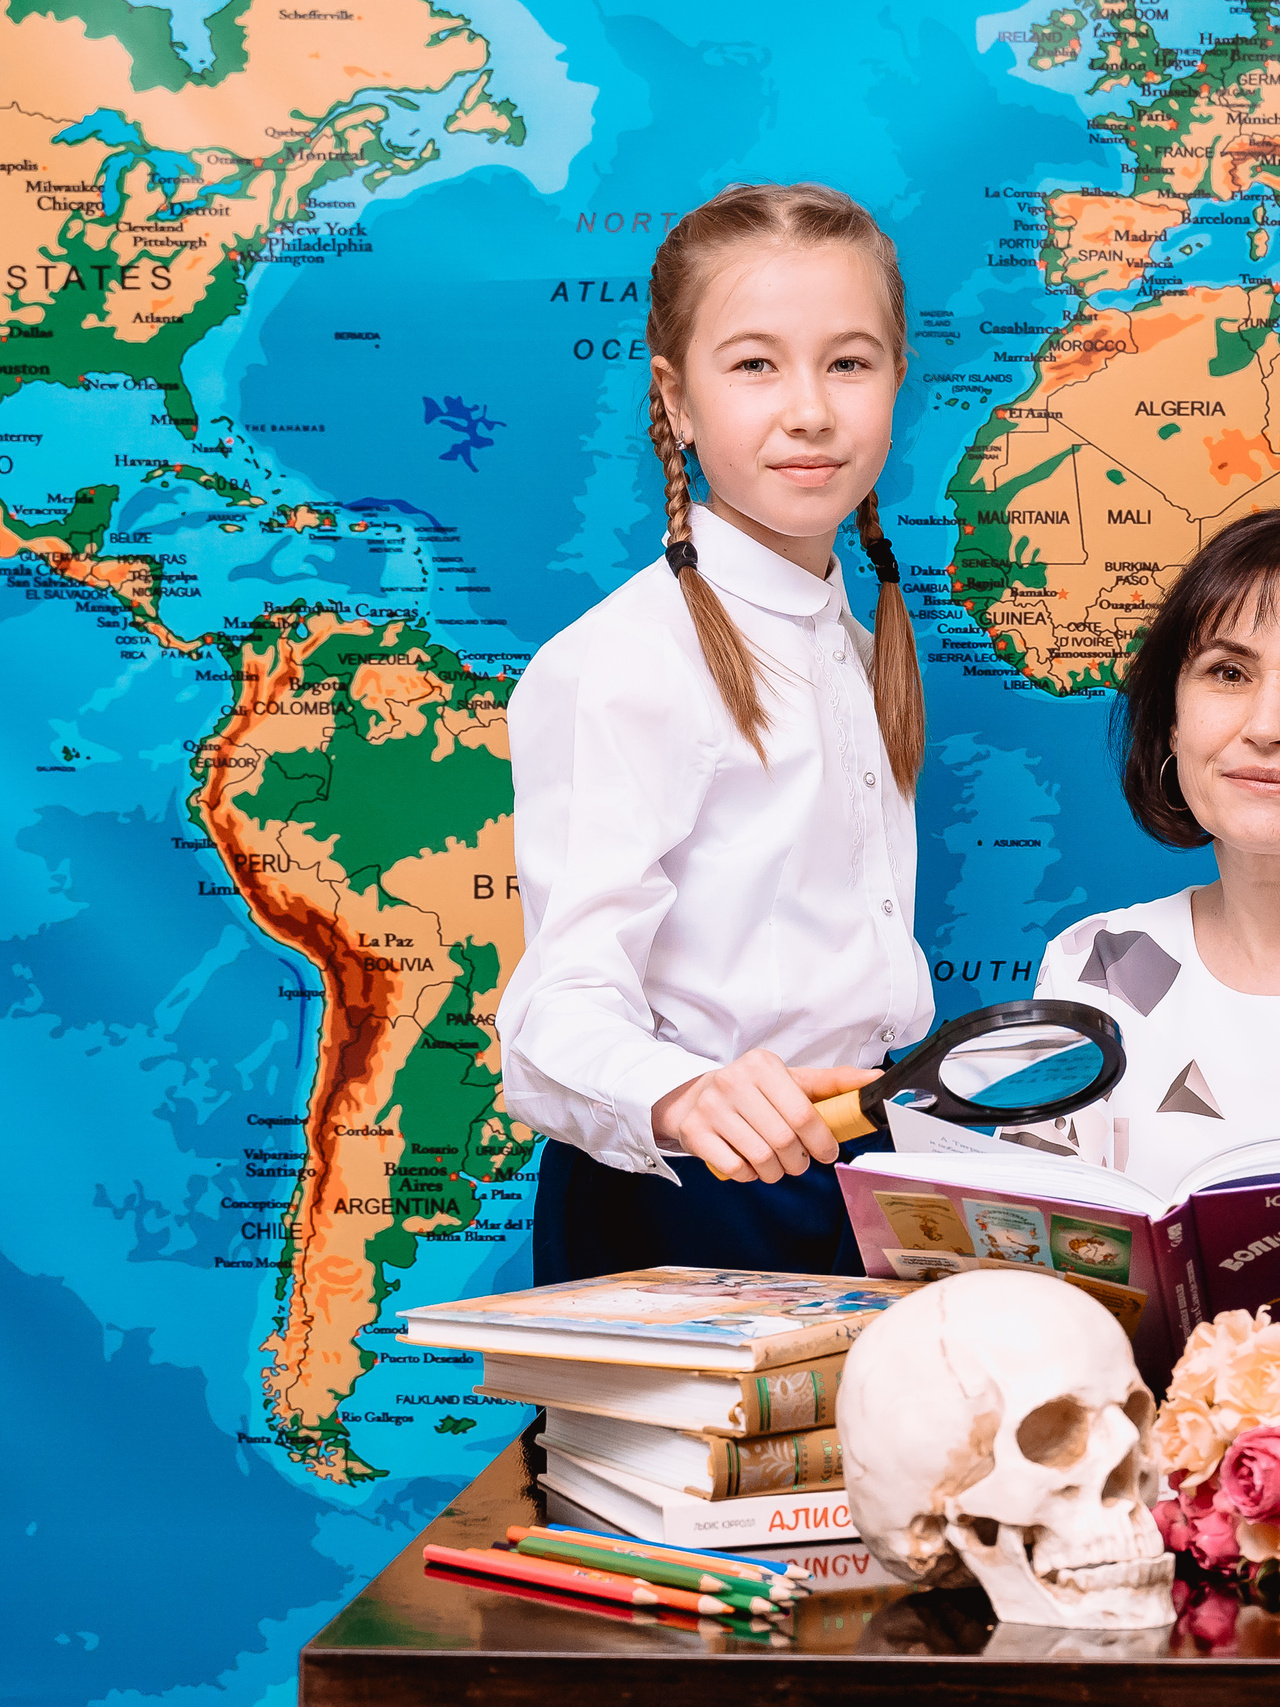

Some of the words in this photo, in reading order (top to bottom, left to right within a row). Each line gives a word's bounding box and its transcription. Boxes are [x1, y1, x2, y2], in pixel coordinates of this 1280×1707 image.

[1089, 58, 1146, 71] London
[1137, 110, 1171, 122] Paris
[286, 147, 364, 162] Montreal
[1155, 146, 1214, 158] FRANCE
[1121, 164, 1174, 174] Bordeaux
[26, 180, 105, 194] Milwaukee
[985, 188, 1000, 198] La
[1003, 188, 1047, 198] Coruna
[37, 196, 106, 213] Chicago
[169, 203, 231, 218] Detroit
[307, 199, 355, 210] Boston
[1016, 202, 1044, 214] Vigo
[576, 212, 677, 233] NORT
[1181, 212, 1250, 225] Barcelona
[116, 221, 184, 233] Cleveland
[280, 223, 320, 237] New
[327, 223, 367, 237] York
[1013, 222, 1047, 231] Porto
[1114, 230, 1167, 242] Madrid
[133, 236, 207, 249] Pittsburgh
[268, 238, 373, 256] Philadelphia
[987, 254, 1038, 266] Lisbon
[1078, 250, 1123, 262] SPAIN
[7, 266, 172, 290] STATES
[550, 281, 652, 302] ATLA
[132, 312, 184, 324] Atlanta
[1062, 310, 1098, 321] Rabat
[8, 327, 54, 338] Dallas
[979, 322, 1060, 334] Casablanca
[573, 339, 646, 360] OCE
[1049, 340, 1126, 351] MOROCCO
[994, 352, 1056, 363] Marrakech
[86, 379, 118, 392] New
[1134, 401, 1225, 416] ALGERIA
[151, 414, 198, 426] Miami
[245, 424, 266, 432] THE
[270, 424, 325, 432] BAHAMAS
[114, 455, 169, 467] Havana
[204, 479, 251, 491] CUBA
[13, 505, 69, 516] Veracruz
[897, 515, 966, 526] Nouakchott
[977, 511, 1070, 525] MAURITANIA
[1108, 510, 1151, 525] MALI
[910, 565, 947, 577] Dakar
[7, 577, 31, 588] San
[33, 577, 86, 588] Salvador
[903, 583, 949, 594] GAMBIA
[26, 589, 41, 600] EL
[44, 589, 108, 600] SALVADOR
[1010, 588, 1058, 598] Bamako
[355, 604, 418, 618] Caracas
[979, 611, 1046, 626] GUINEA
[115, 635, 151, 645] COSTA
[121, 650, 146, 659] RICA
[337, 653, 424, 666] VENEZUELA
[456, 650, 531, 663] Georgetown
[963, 665, 1020, 677] Monrovia
[289, 678, 348, 694] Bogota
[1004, 680, 1049, 691] LIBERIA
[253, 702, 347, 715] COLOMBIA
[196, 757, 256, 769] ECUADOR
[235, 854, 290, 873] PERU
[358, 933, 380, 948] La
[385, 933, 414, 949] Paz
[364, 957, 433, 972] BOLIVIA
[934, 961, 1032, 981] OUTH
[334, 1125, 394, 1137] Cordoba
[245, 1164, 316, 1180] Santiago
[384, 1163, 447, 1177] Buenos
[399, 1179, 442, 1192] Aires
[473, 1190, 486, 1201] La
[490, 1190, 522, 1202] Plata
[334, 1198, 460, 1215] ARGENTINA
[241, 1222, 303, 1239] CHILE
[475, 1220, 500, 1230] Mar
[504, 1220, 523, 1230] del
[426, 1231, 461, 1242] Bahia
[465, 1231, 506, 1242] Blanca
[380, 1353, 419, 1364] Puerto
[423, 1353, 474, 1364] Deseado
[342, 1412, 366, 1423] Rio
[368, 1412, 414, 1424] Gallegos
[768, 1505, 853, 1533] АЛИС
